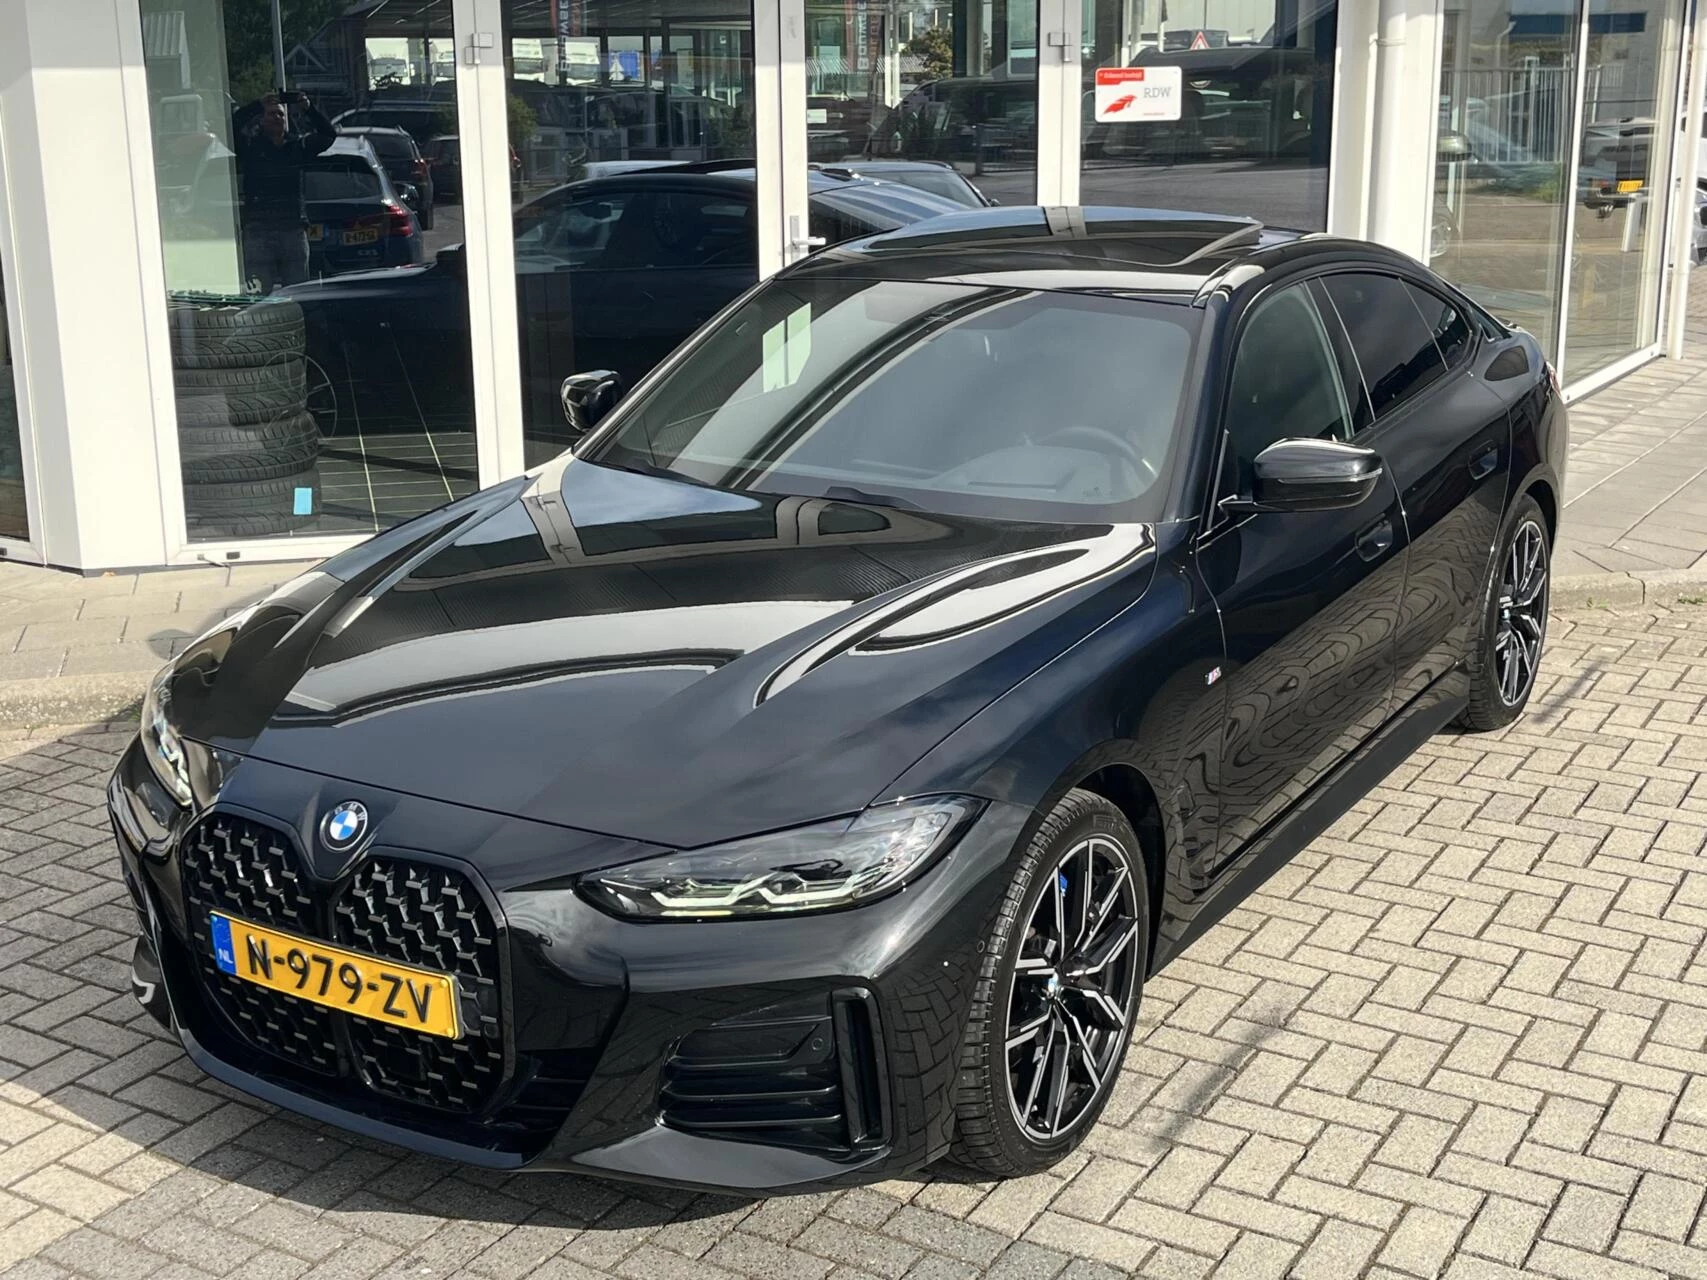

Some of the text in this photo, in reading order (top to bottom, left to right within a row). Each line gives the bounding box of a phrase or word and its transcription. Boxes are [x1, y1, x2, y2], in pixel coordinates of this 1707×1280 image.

[1143, 86, 1172, 99] RDW
[218, 947, 233, 964] NL
[246, 934, 432, 1023] N-979-ZV
